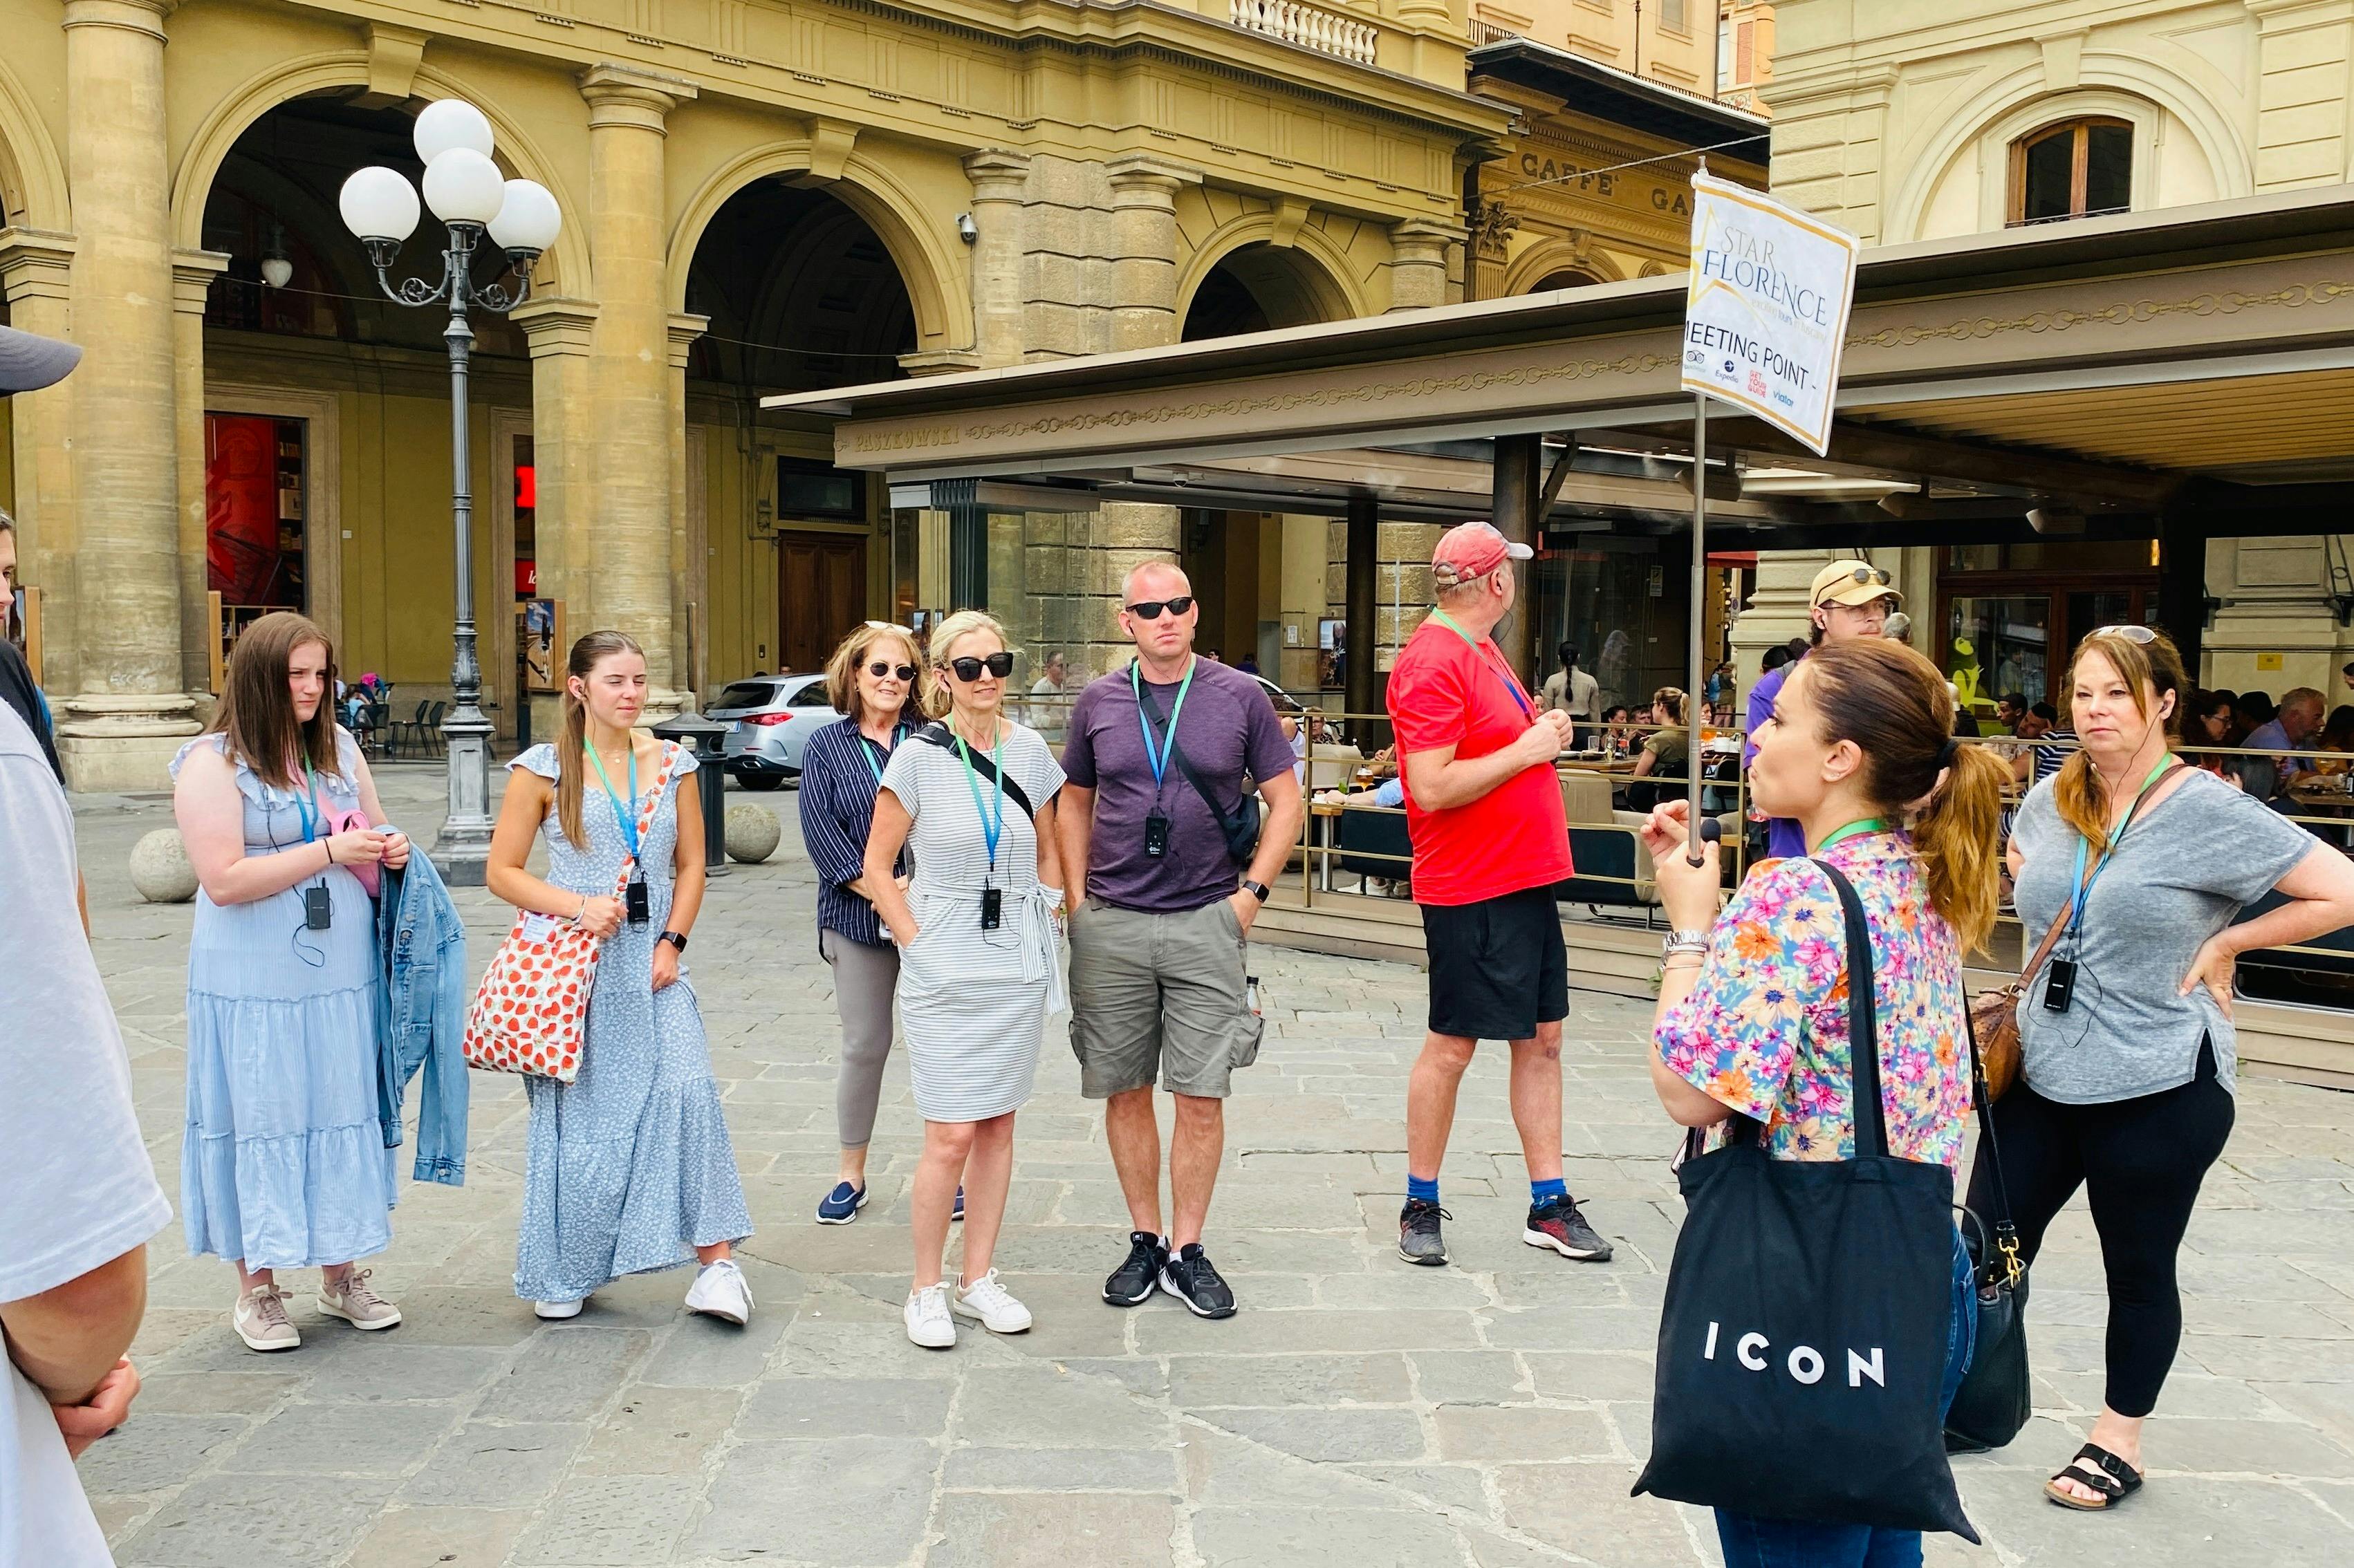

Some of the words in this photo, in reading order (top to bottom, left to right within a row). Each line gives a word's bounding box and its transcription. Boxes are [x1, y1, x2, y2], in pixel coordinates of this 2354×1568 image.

[1652, 188, 1694, 216] GA
[1721, 226, 1775, 268] STAR
[1703, 249, 1827, 326] FLORENCE
[1778, 309, 1792, 326] tours
[1715, 369, 1739, 383] Expedia
[1750, 370, 1762, 380] GET
[1763, 347, 1808, 390] POINT
[1748, 384, 1766, 398] GUIDE
[1750, 377, 1767, 389] YOUR
[1773, 389, 1794, 408] viator
[855, 424, 961, 453] PASZKOWSKI
[1704, 1321, 1885, 1388] ICON
